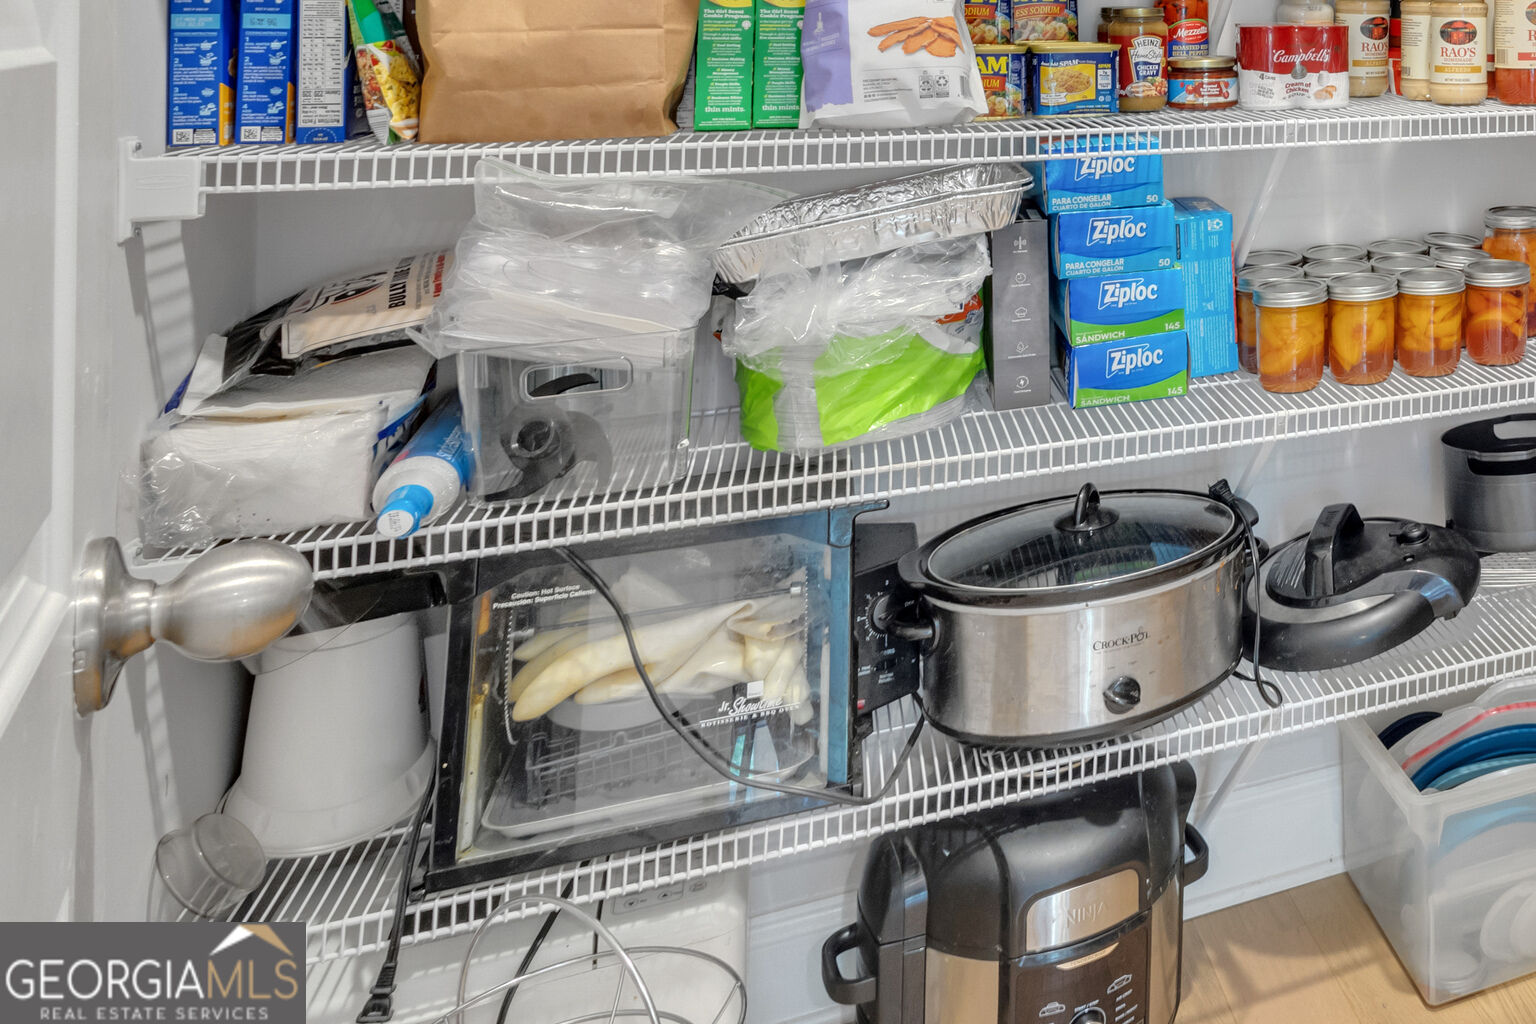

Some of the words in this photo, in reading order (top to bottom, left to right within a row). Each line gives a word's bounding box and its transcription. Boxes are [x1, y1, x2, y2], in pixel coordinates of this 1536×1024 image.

[1029, 4, 1060, 15] SODIUM
[1136, 38, 1160, 49] HEINZ
[1360, 41, 1388, 52] RAO'S
[1272, 47, 1331, 64] Campbell's
[1440, 45, 1476, 57] RAO'S
[1136, 63, 1160, 71] CHICKEN
[1139, 70, 1157, 78] GRAVY
[1285, 82, 1303, 90] Cream
[1285, 86, 1310, 95] Chicken
[1080, 155, 1135, 180] Ziploc
[1052, 196, 1071, 205] PARA
[1071, 193, 1112, 204] CONGELAR
[1146, 194, 1159, 203] 50
[1052, 203, 1078, 211] CUARTO
[1092, 220, 1147, 244] Ziploc
[1065, 261, 1084, 270] PARA
[1084, 258, 1125, 269] CONGELAR
[1158, 258, 1171, 267] 50
[389, 281, 406, 308] BULLY
[1104, 282, 1159, 308] Ziploc
[1164, 322, 1181, 331] 145
[1075, 330, 1126, 343] SANDWICH
[1110, 347, 1164, 374] Ziploc
[1167, 386, 1184, 395] 145
[1080, 394, 1131, 407] SANDWICH
[511, 587, 540, 600] Caution:
[541, 586, 554, 595] Hot
[555, 584, 580, 594] Surface
[534, 591, 568, 604] Superficie
[569, 587, 597, 598] Caliente
